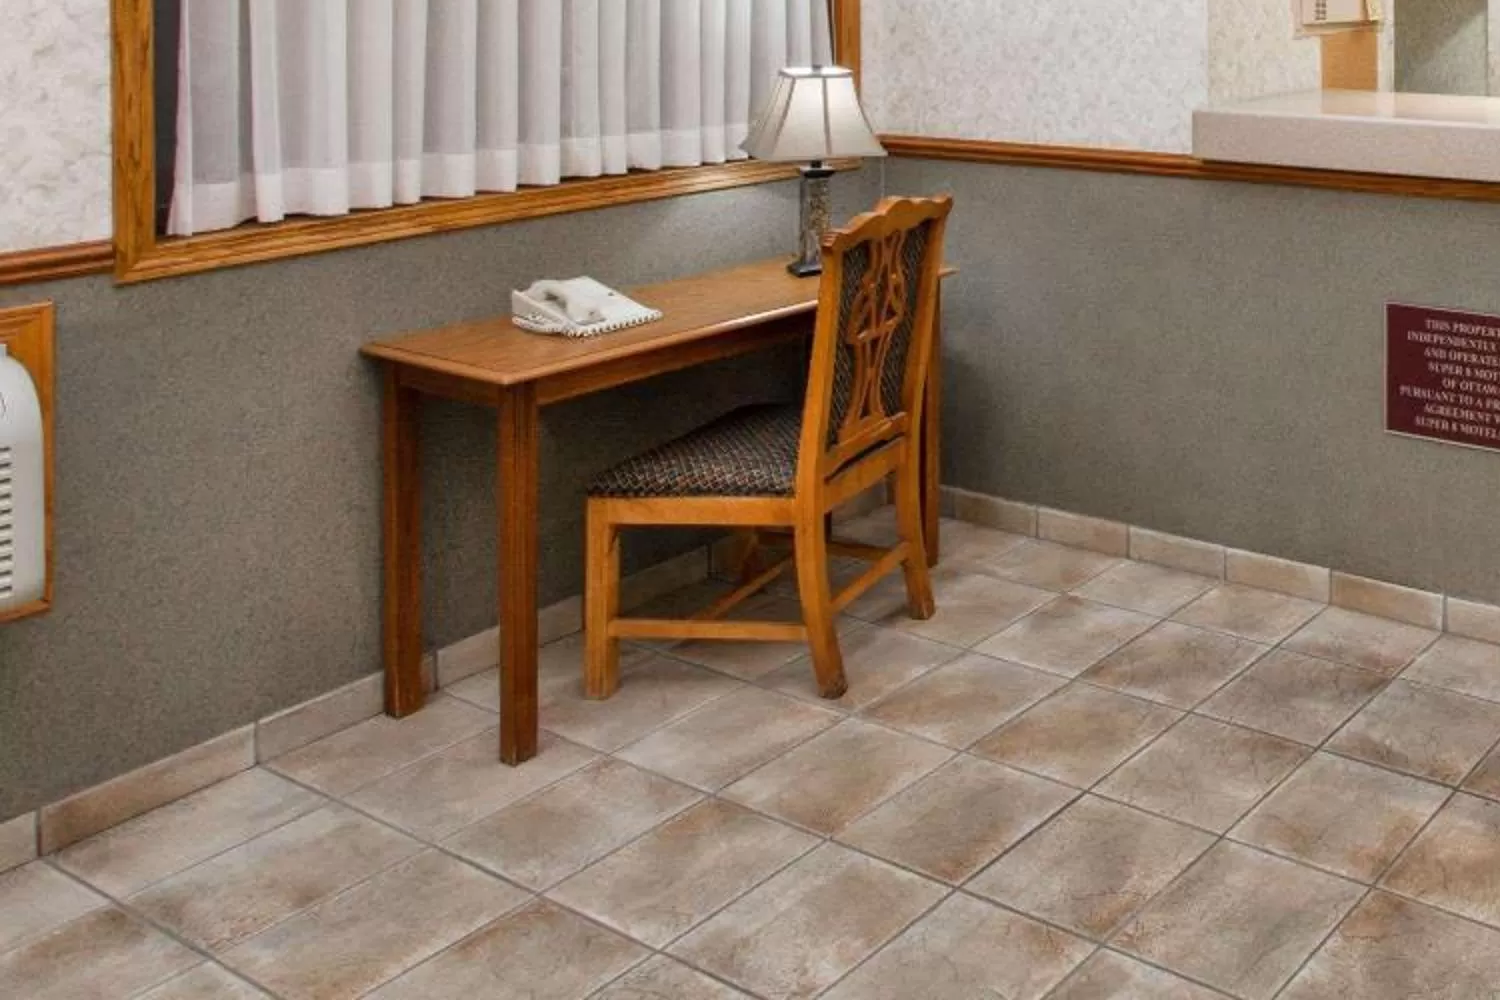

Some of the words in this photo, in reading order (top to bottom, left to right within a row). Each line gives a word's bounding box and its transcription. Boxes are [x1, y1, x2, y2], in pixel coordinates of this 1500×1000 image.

[1425, 319, 1450, 331] THIS
[1407, 330, 1498, 351] INDEPENDENTLY
[1424, 347, 1447, 359] AND
[1427, 361, 1463, 375] SUPER
[1465, 366, 1472, 377] 8
[1442, 377, 1457, 389] OF
[1400, 385, 1457, 401] PURSUANT
[1458, 393, 1473, 405] TO
[1475, 396, 1483, 408] A
[1424, 403, 1491, 423] AGREEMENT
[1415, 416, 1449, 431] SUPER
[1451, 421, 1458, 433] 8
